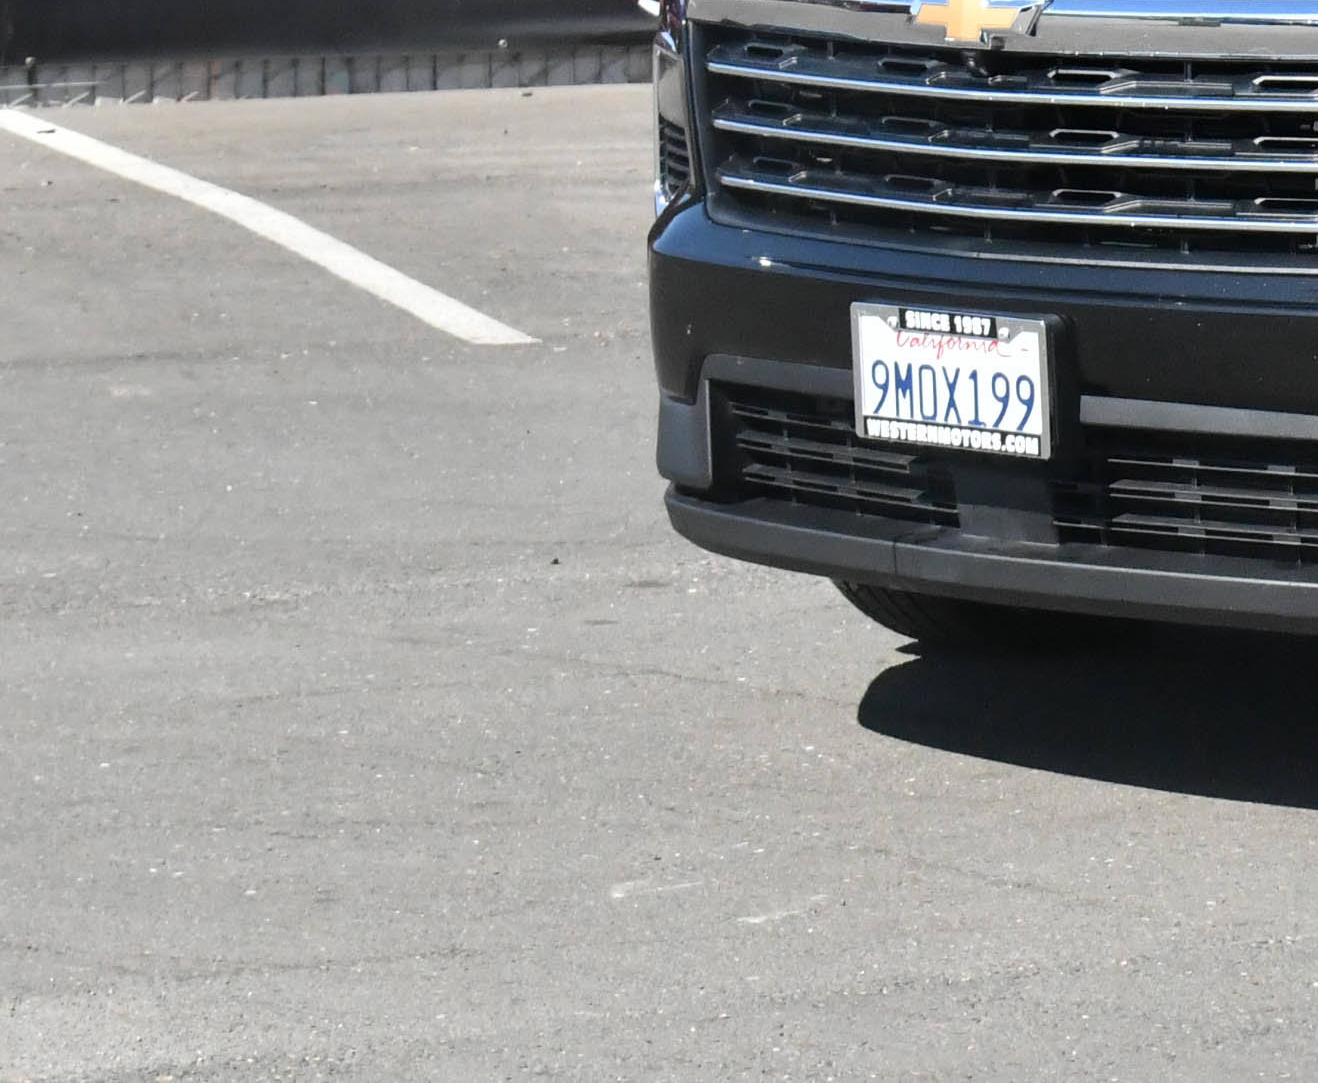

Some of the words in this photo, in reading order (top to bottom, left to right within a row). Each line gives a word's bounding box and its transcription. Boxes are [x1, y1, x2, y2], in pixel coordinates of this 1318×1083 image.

[904, 310, 951, 333] SINCE
[871, 359, 1035, 431] 9MOX199
[866, 418, 1040, 455] WESTERNMOTORS.COM
